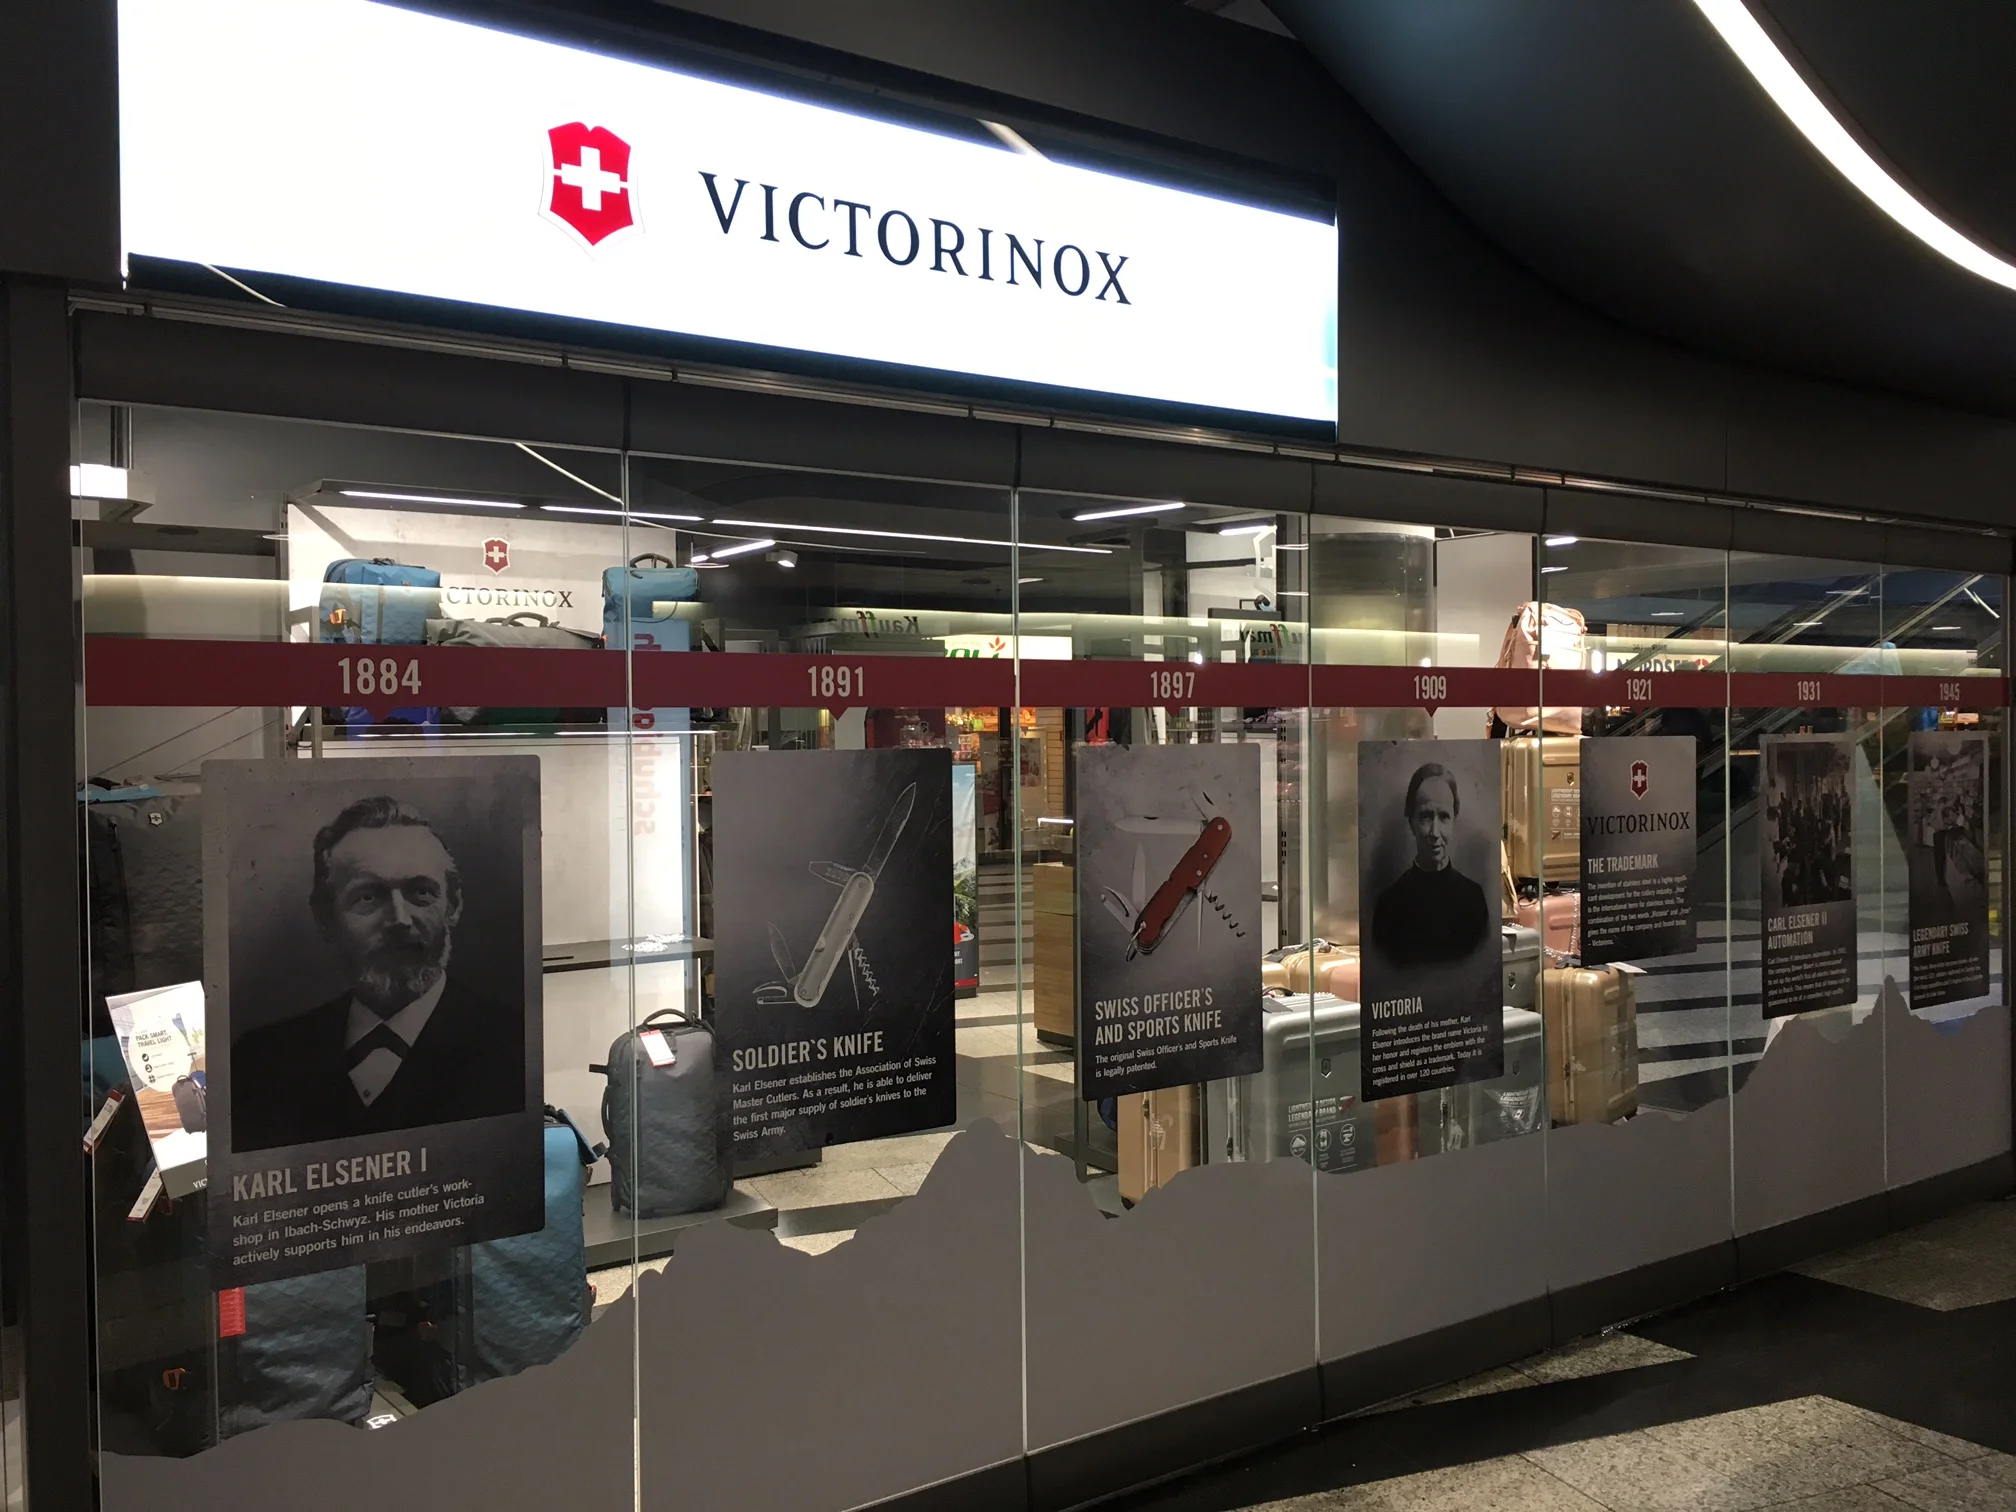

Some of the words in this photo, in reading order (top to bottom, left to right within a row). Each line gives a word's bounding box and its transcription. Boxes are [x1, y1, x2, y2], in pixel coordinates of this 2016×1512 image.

[698, 171, 1132, 305] VICTORINOX
[439, 586, 573, 608] ICTORINOX
[338, 658, 422, 694] 1884
[808, 666, 864, 697] 1891
[1150, 671, 1195, 698] 1897
[1414, 675, 1446, 700] 1909
[1626, 678, 1652, 700] 1921
[1798, 680, 1820, 700] 1931
[1940, 683, 1960, 700] 1945
[1587, 812, 1690, 835] VICTORINOX
[1589, 858, 1605, 874] THE
[1608, 854, 1659, 872] TRADEMARK
[1768, 918, 1786, 932] CARL
[1788, 913, 1820, 930] ELSENER
[1822, 912, 1828, 925] II
[1913, 925, 1948, 942] LEGENDARY
[1949, 922, 1969, 937] SWISS
[1768, 930, 1814, 950] AUTOMATION
[1096, 997, 1140, 1021] SWISS
[1372, 997, 1423, 1019] VICTORIA
[1096, 1024, 1123, 1045] AND
[1128, 1016, 1180, 1040] SPORTS
[1184, 1010, 1222, 1032] KNIFE
[1372, 1028, 1397, 1037] Following
[1408, 1023, 1424, 1031] death
[1424, 1021, 1430, 1029] of
[157, 1035, 172, 1044] LIGHT
[834, 1032, 883, 1058] KNIFE
[1096, 1055, 1108, 1063] The
[1110, 1050, 1134, 1062] original
[1137, 1049, 1154, 1058] Swiss
[1185, 1041, 1196, 1050] and
[1199, 1039, 1219, 1048] Sports
[1221, 1035, 1237, 1044] Knife
[1372, 1041, 1392, 1049] Elsener
[1393, 1036, 1421, 1046] introduces
[1432, 1031, 1447, 1040] brand
[1399, 1048, 1410, 1057] and
[1410, 1046, 1433, 1056] registers
[1443, 1041, 1464, 1049] emblem
[1465, 1038, 1476, 1046] with
[732, 1082, 751, 1093] Karl
[754, 1079, 787, 1090] Elsener
[789, 1071, 837, 1084] establishes
[839, 1068, 853, 1078] the
[855, 1061, 902, 1075] Association
[903, 1058, 912, 1068] of
[914, 1056, 937, 1066] Swiss
[1096, 1069, 1102, 1078] is
[1104, 1066, 1125, 1077] legally
[1126, 1061, 1158, 1074] patented.
[1388, 1062, 1398, 1071] and
[1399, 1059, 1415, 1069] shield
[1373, 1075, 1398, 1086] registered
[1420, 1069, 1430, 1077] 120
[734, 1098, 762, 1108] Master
[766, 1093, 800, 1104] Cutlers.
[803, 1089, 813, 1098] As
[825, 1084, 850, 1095] result,
[854, 1082, 864, 1090] he
[867, 1080, 873, 1088] is
[876, 1077, 893, 1087] able
[896, 1076, 904, 1084] to
[906, 1072, 932, 1082] deliver
[733, 1116, 748, 1125] the
[751, 1111, 768, 1122] first
[771, 1108, 796, 1119] major
[798, 1102, 826, 1115] supply
[828, 1099, 837, 1110] of
[876, 1092, 901, 1102] knives
[903, 1089, 912, 1098] to
[914, 1087, 927, 1096] the
[733, 1130, 758, 1141] Swiss
[761, 1126, 786, 1136] Army.
[234, 1169, 297, 1201] KARL
[307, 1152, 411, 1190] ELSENER
[421, 1148, 427, 1172] I
[233, 1213, 258, 1227] Karl
[264, 1208, 308, 1222] Elsener
[313, 1201, 349, 1215] opens
[353, 1199, 360, 1208] a
[365, 1192, 394, 1205] knife
[443, 1179, 472, 1192] work-
[233, 1234, 263, 1246] shop
[268, 1229, 280, 1240] in
[285, 1216, 371, 1237] Ibach-Schwyz.
[376, 1209, 395, 1221] His
[399, 1203, 439, 1217] mother
[444, 1194, 484, 1209] Victoria
[233, 1248, 280, 1265] actively
[284, 1239, 337, 1256] supports
[342, 1234, 364, 1246] him
[369, 1230, 379, 1241] in
[384, 1226, 401, 1238] his
[405, 1218, 464, 1234] endeavors.
